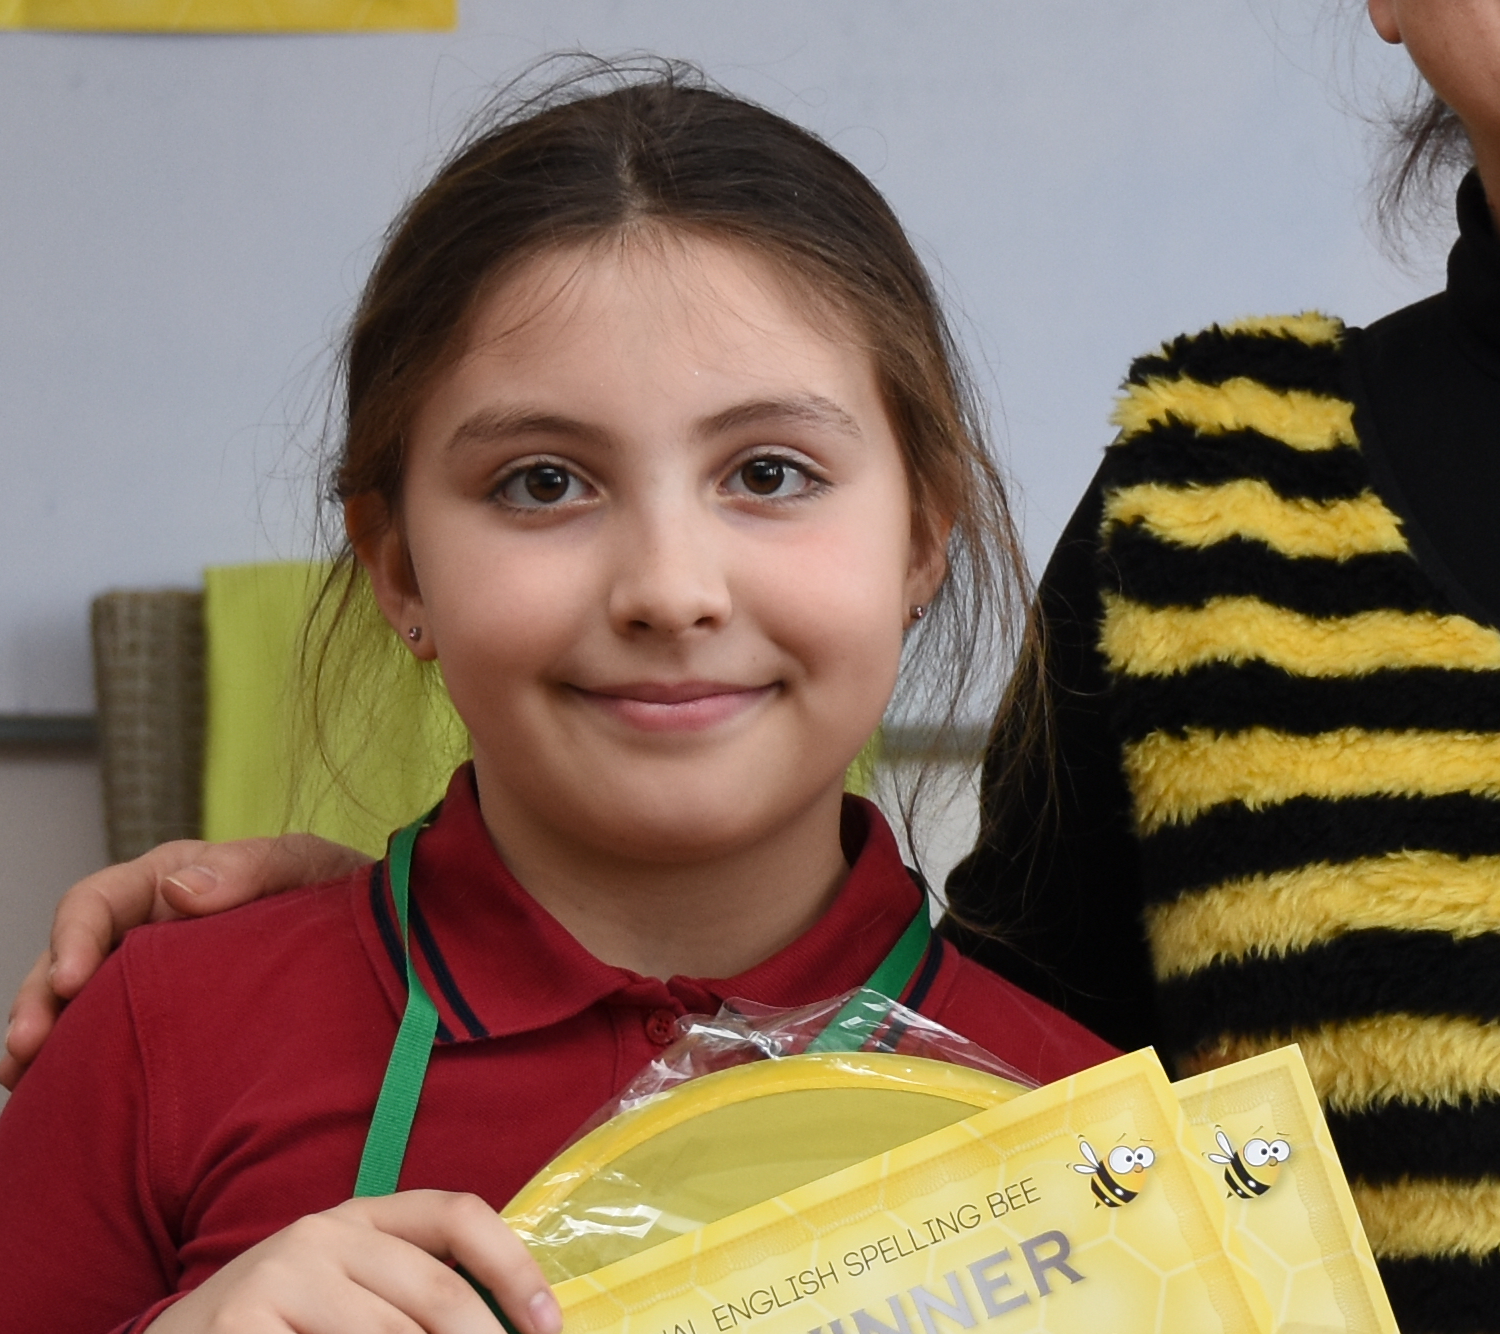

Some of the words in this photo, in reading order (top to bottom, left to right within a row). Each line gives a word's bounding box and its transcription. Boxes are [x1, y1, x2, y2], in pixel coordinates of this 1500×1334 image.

[712, 1261, 840, 1332] ENGLISH
[843, 1203, 981, 1278] SPELLING
[985, 1177, 1041, 1219] BEE
